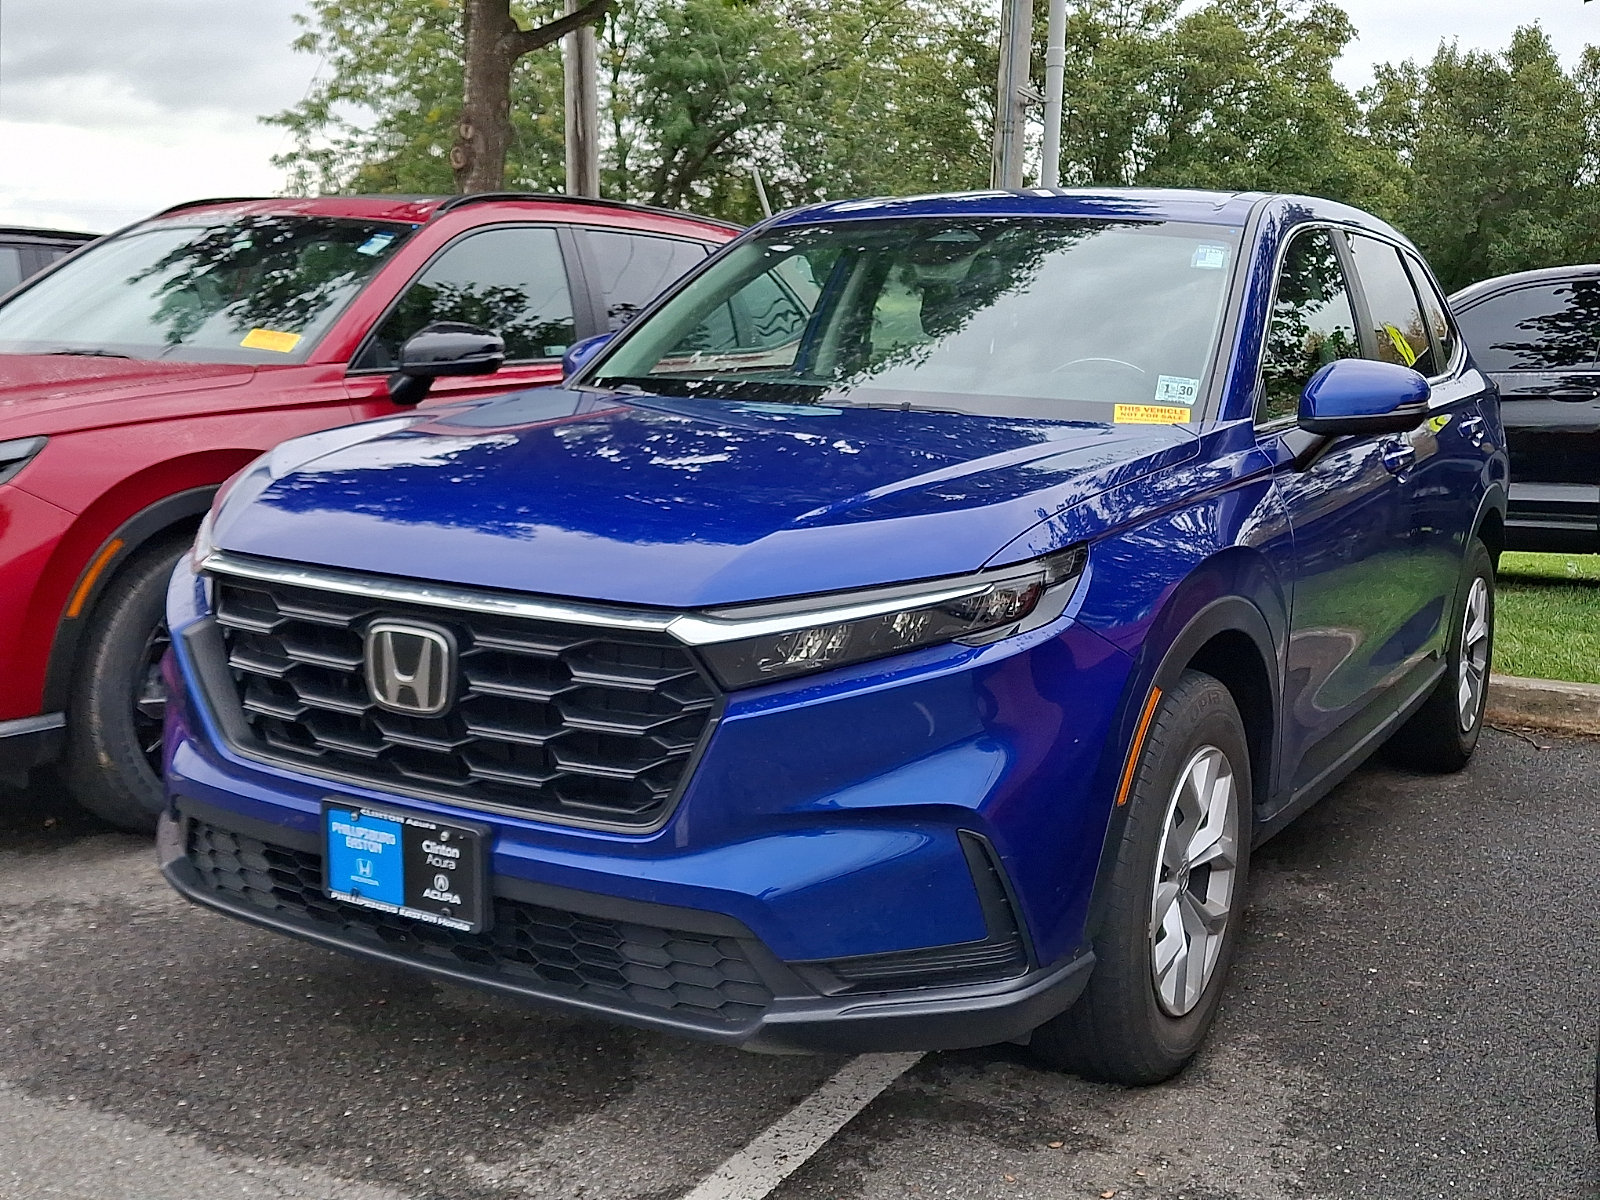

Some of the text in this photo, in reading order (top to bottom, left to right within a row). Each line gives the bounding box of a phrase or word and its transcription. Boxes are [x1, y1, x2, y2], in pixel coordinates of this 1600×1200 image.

[1179, 386, 1194, 396] 30
[1118, 405, 1187, 416] THIS VEHICLE
[1161, 413, 1185, 421] SALE
[421, 840, 460, 859] Clinton
[426, 854, 457, 870] Acura
[422, 888, 462, 906] ACURA
